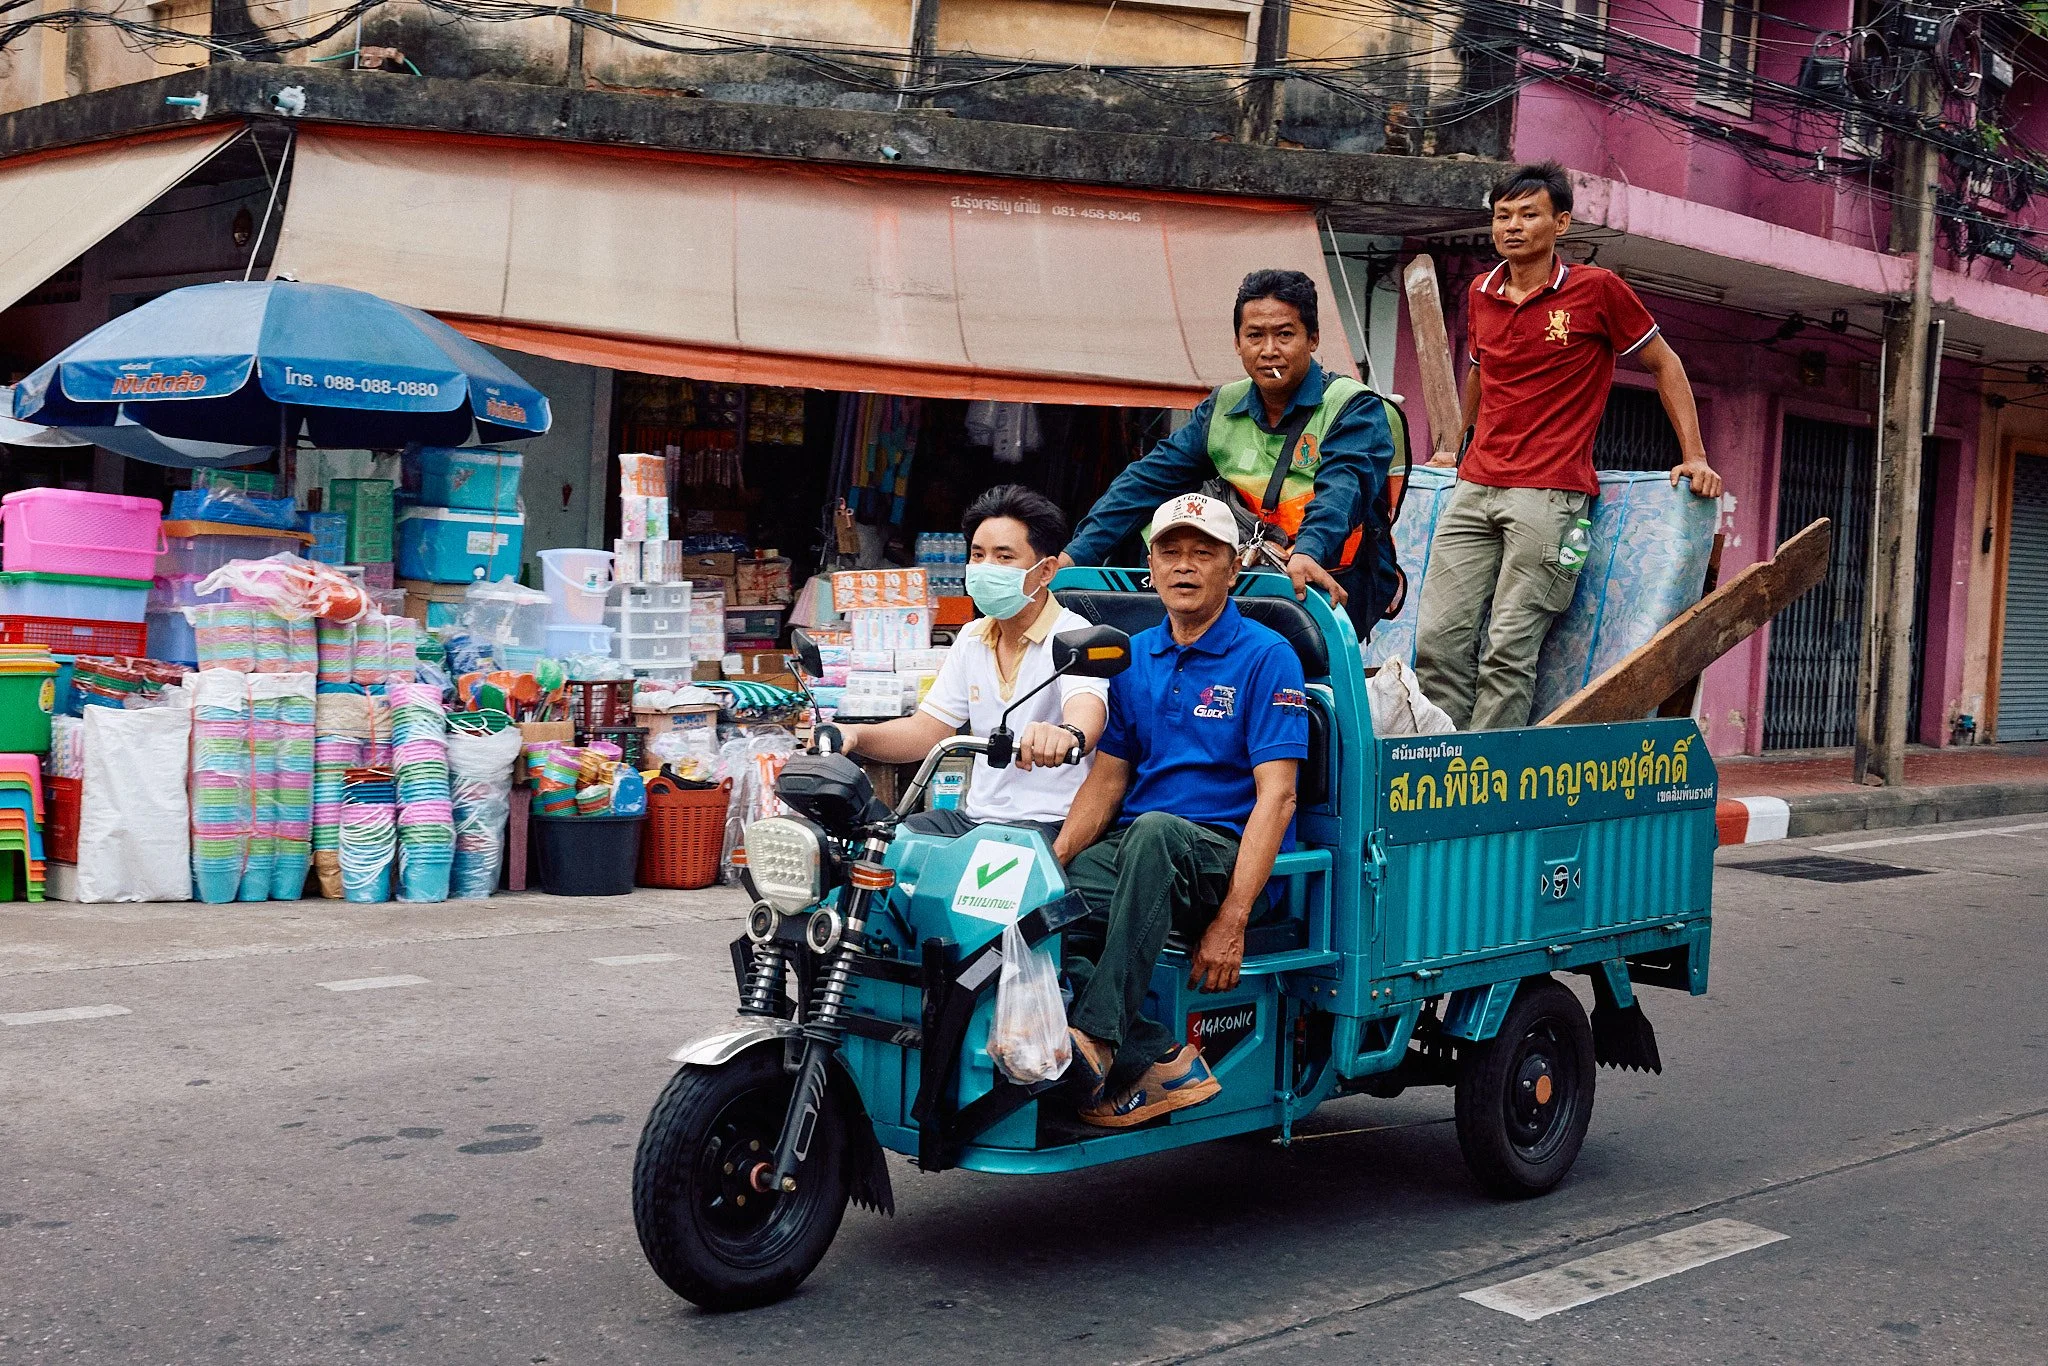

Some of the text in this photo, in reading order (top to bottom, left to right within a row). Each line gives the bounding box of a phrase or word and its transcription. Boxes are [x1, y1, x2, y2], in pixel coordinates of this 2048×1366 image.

[1052, 205, 1141, 222] 081-458-8046
[323, 374, 439, 397] 088-088-0880
[1391, 742, 1463, 763] สนับสนุนโดย
[1389, 733, 1697, 813] ส.ก.พินิจ กาญจนชูศักดิ์
[956, 895, 1017, 910] เราแยกขยะ
[1192, 1010, 1254, 1037] SAGASONIC
